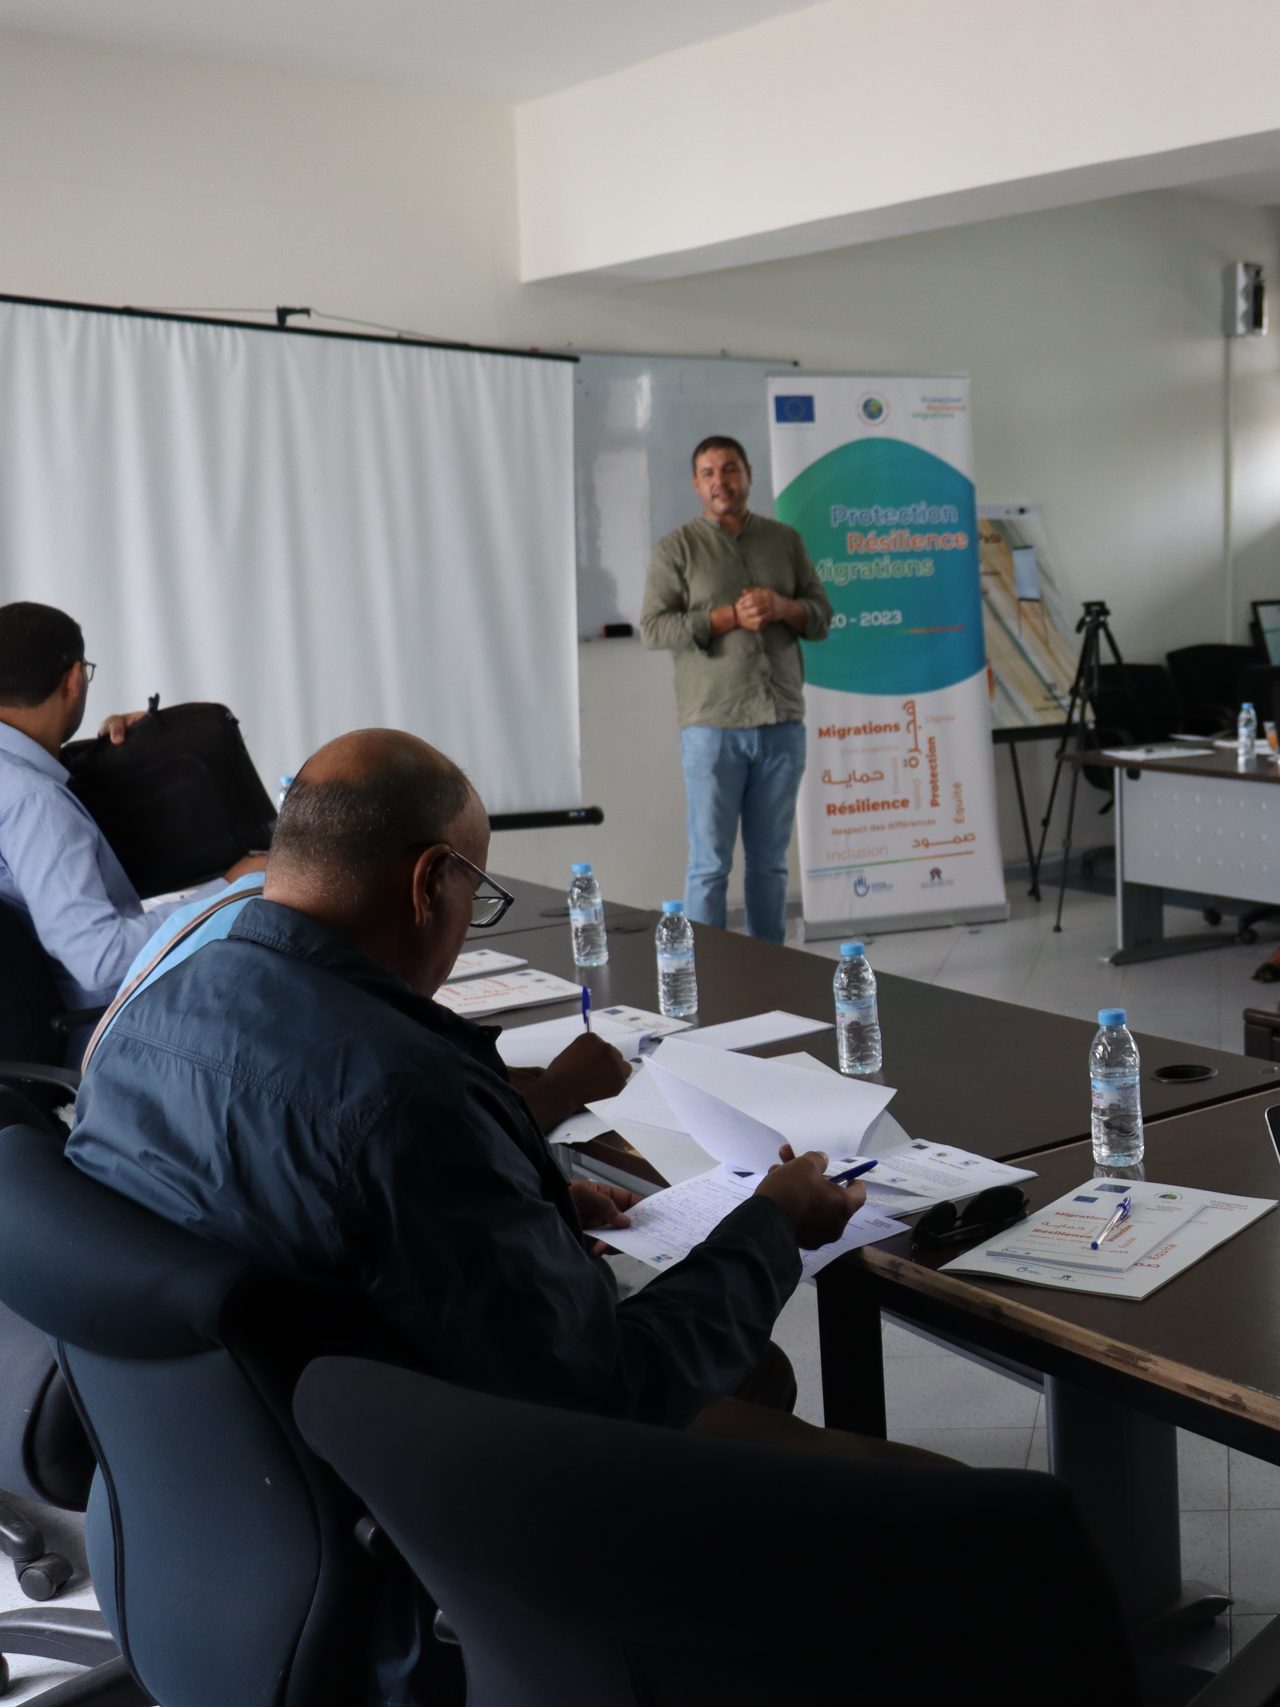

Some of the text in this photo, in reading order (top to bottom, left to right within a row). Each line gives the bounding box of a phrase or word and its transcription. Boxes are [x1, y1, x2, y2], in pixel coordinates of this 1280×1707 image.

[831, 502, 958, 527] Protection
[847, 530, 969, 554] Résilience
[860, 610, 902, 627] 2023
[818, 721, 901, 740] Migrations
[927, 736, 941, 808] Protection
[826, 797, 910, 817] Résilience
[831, 824, 867, 836] Respect
[870, 823, 885, 832] des
[826, 845, 888, 862] Inclusion
[1054, 1211, 1107, 1221] Migration
